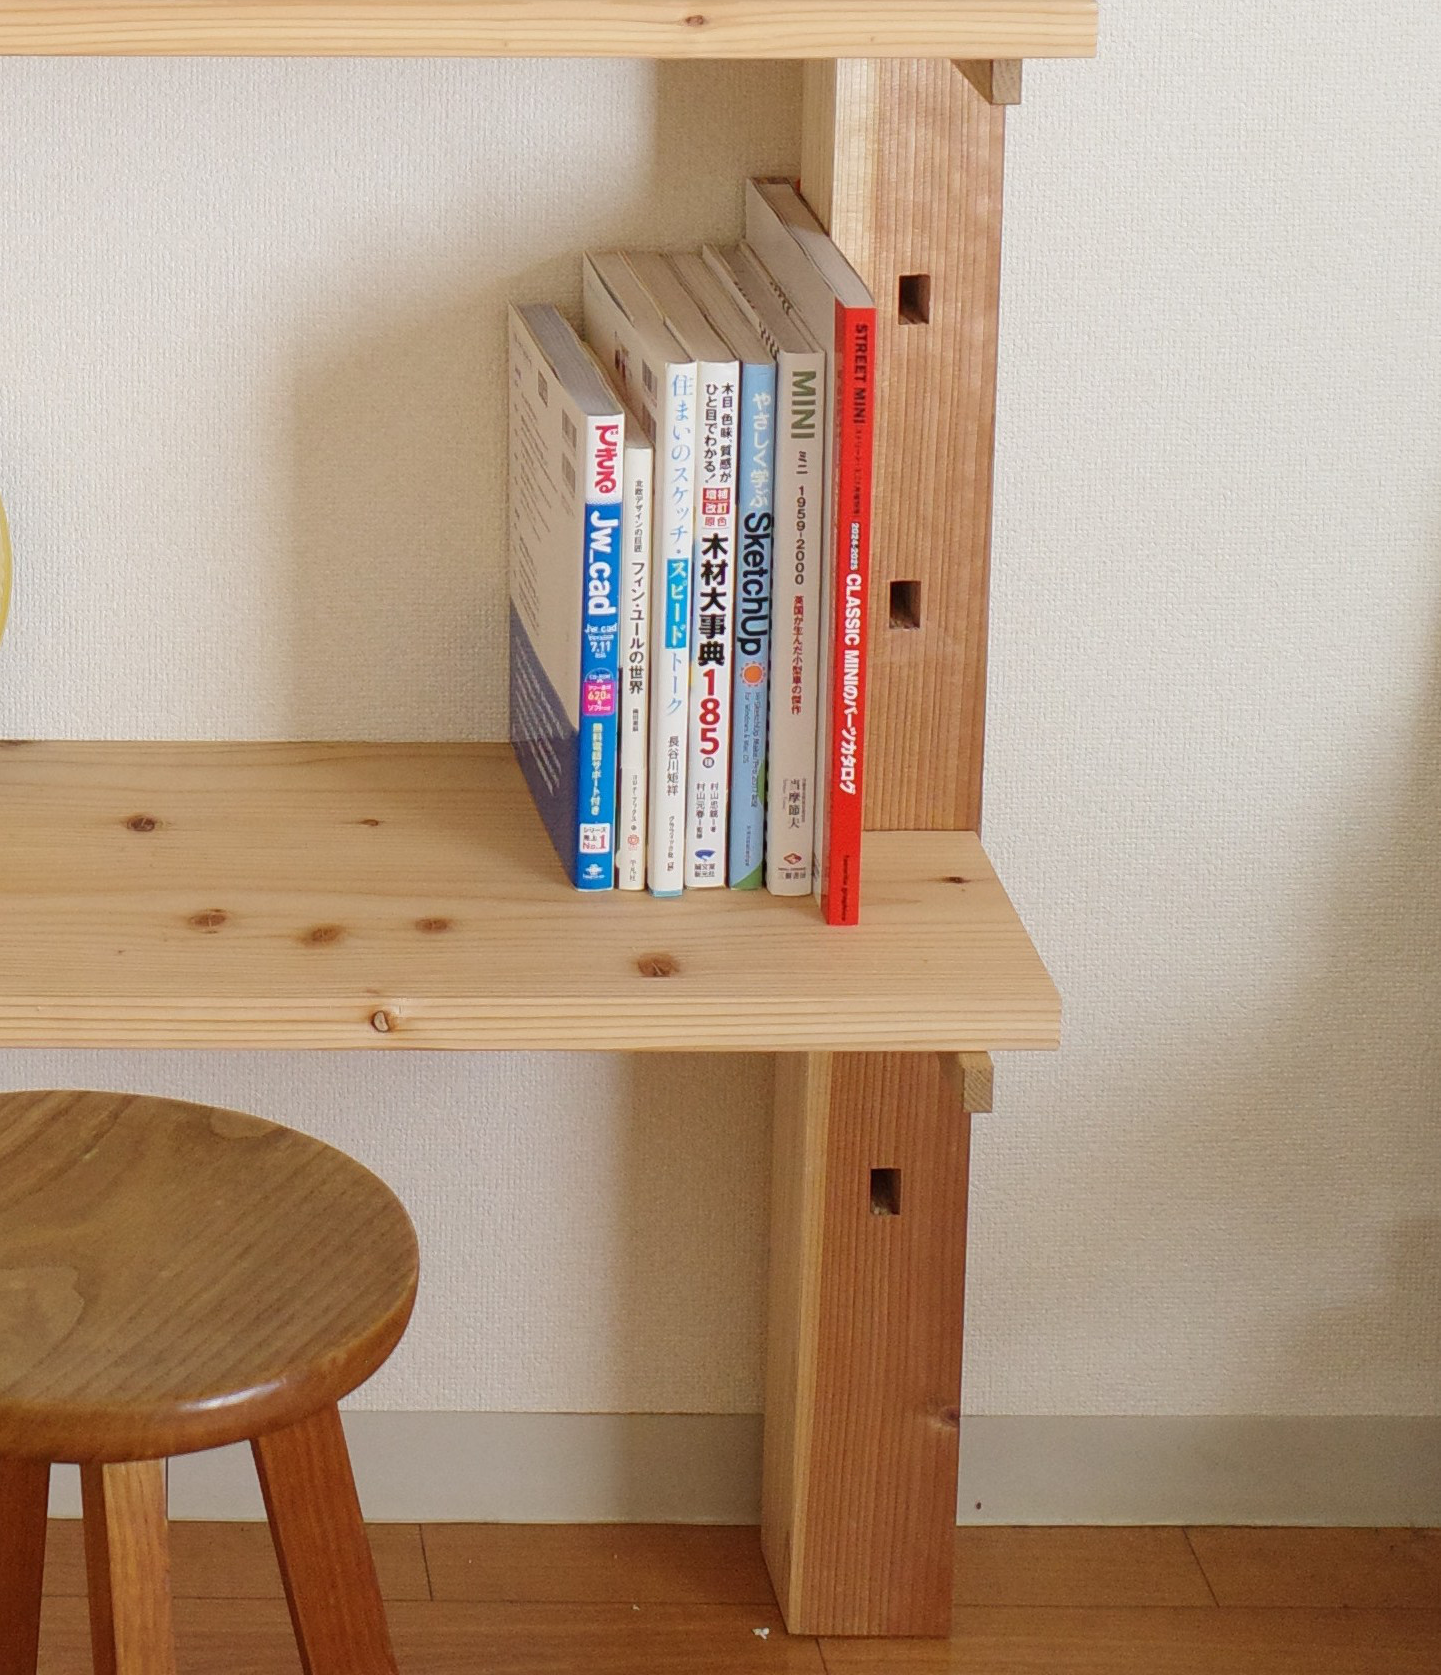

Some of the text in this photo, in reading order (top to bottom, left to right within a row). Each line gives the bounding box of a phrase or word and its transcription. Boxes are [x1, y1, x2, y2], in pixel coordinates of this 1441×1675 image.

[854, 323, 868, 383] STREET
[790, 369, 816, 439] MINI
[853, 387, 867, 425] MINI
[595, 425, 619, 494] できる
[749, 391, 771, 508] やさしく学ぶ
[796, 450, 808, 475] ミニ
[588, 511, 619, 616] Jw_cad
[795, 484, 806, 585] 1959-2000
[737, 512, 772, 656] SketchUp
[844, 573, 862, 646] CLASSIC
[629, 561, 645, 694] フィン・ユールの世界
